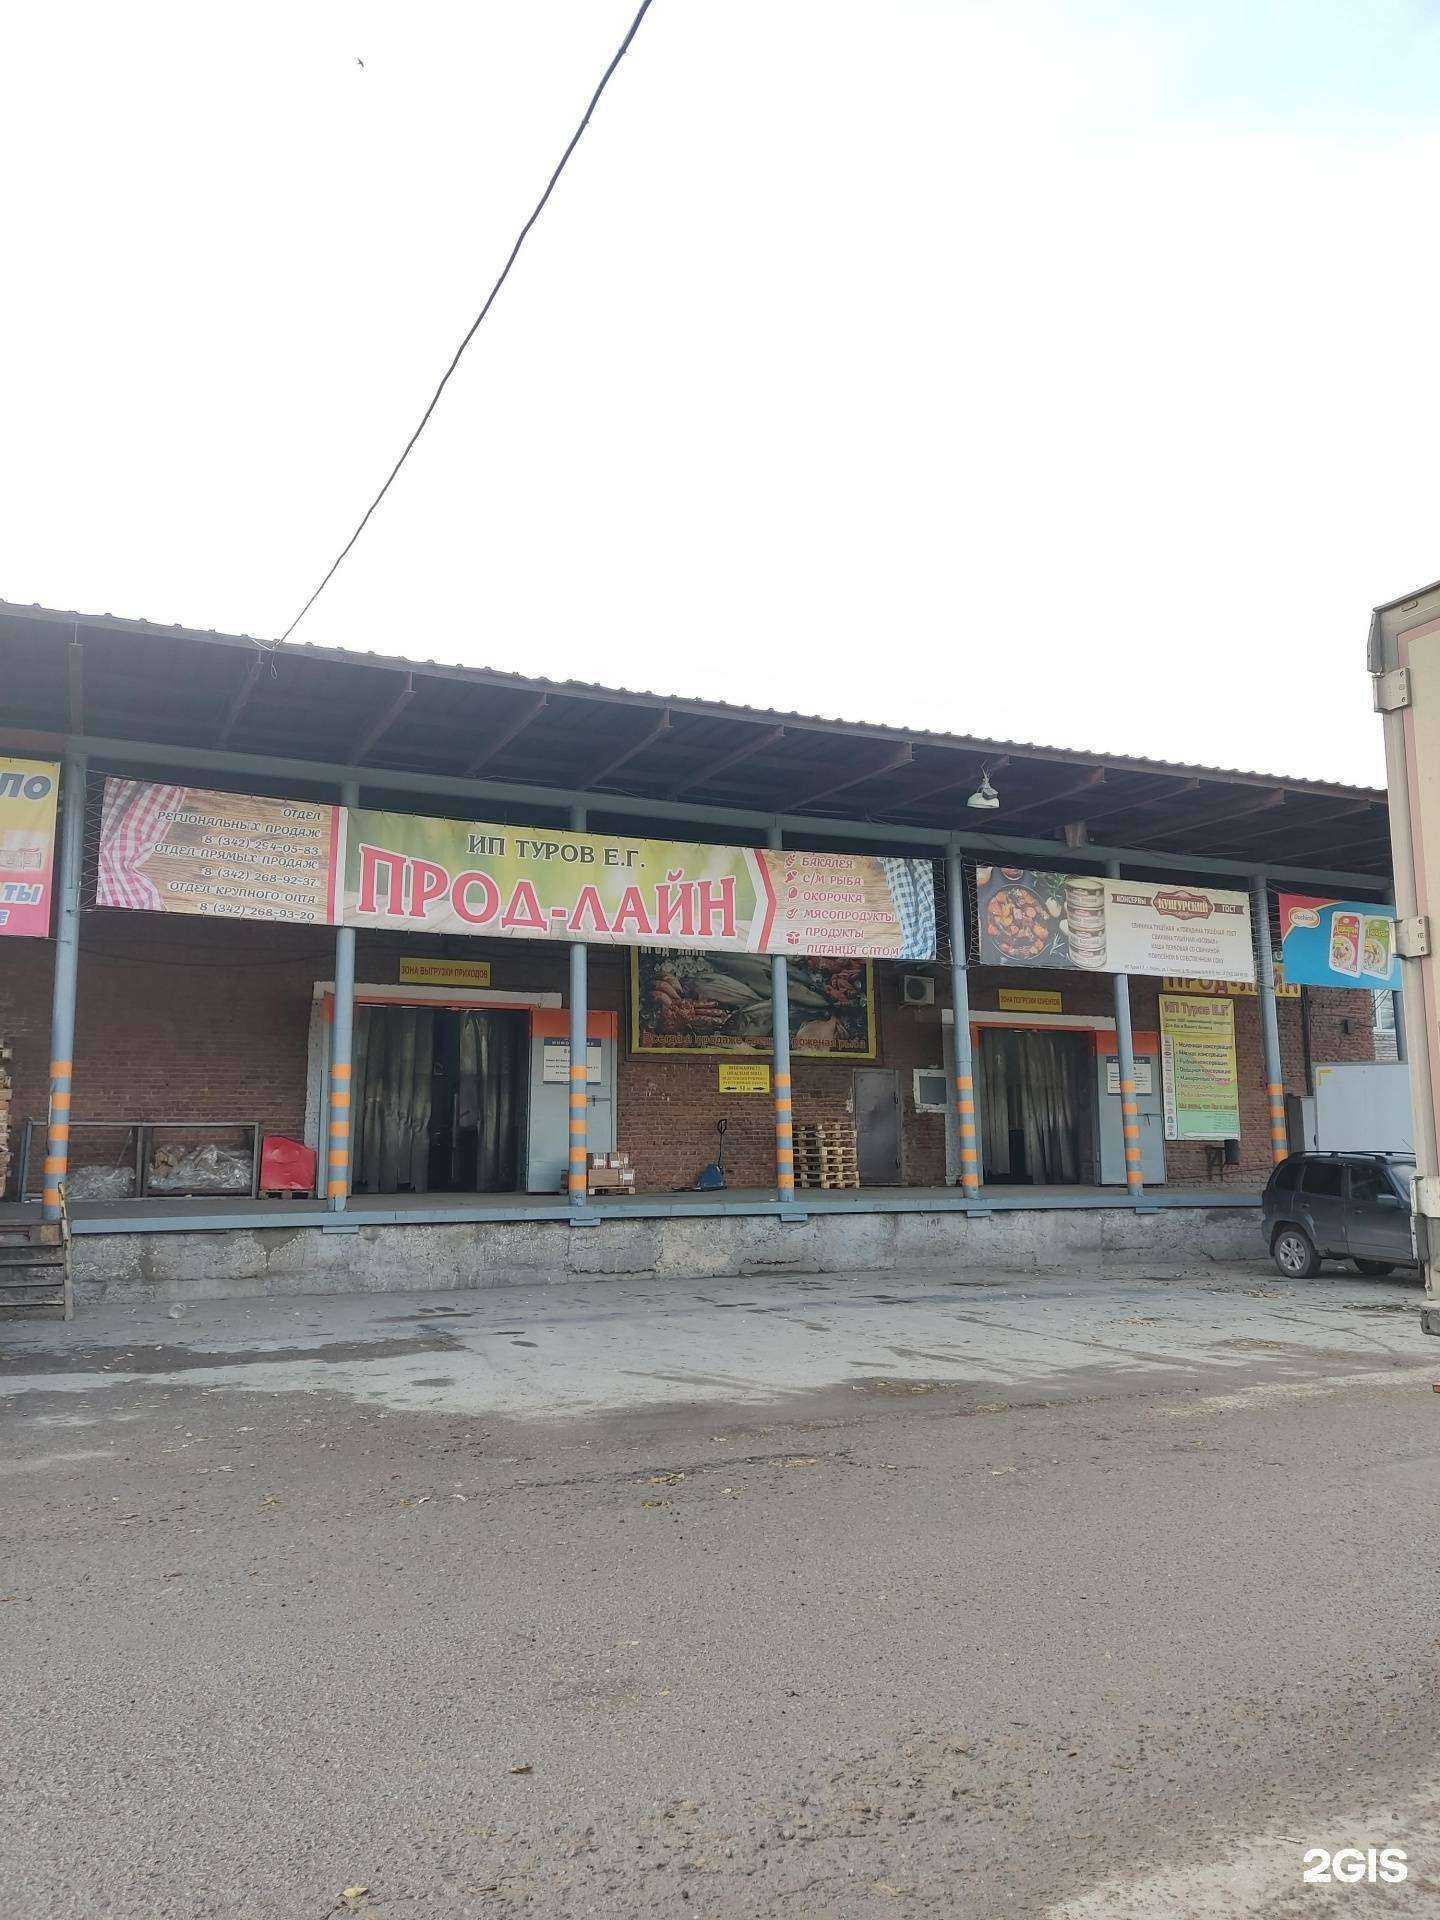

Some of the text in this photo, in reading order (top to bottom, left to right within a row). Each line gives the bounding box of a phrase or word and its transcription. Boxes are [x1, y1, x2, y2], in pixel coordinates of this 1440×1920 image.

[283, 808, 321, 821] ОТДЕЛ
[157, 811, 321, 838] РЕГИОНАЛЬНЫХ ПРОДАЖ
[203, 835, 213, 845] 8
[217, 835, 250, 849] (342)
[154, 843, 318, 870] ОТДЕЛ ПРЯМЫХ ПРОДАЖ
[467, 833, 646, 869] ИП ТУРОВ Е.Г.
[801, 856, 854, 869] БАКАЛЕЯ
[203, 867, 212, 876] 8
[217, 867, 250, 881] (342)
[802, 872, 862, 887] С/М РЫБА
[169, 881, 316, 904] ОТДЕЛ КРУПНОГО ОПТА
[357, 843, 738, 938] ПРОД-ЛАЙН
[803, 891, 863, 904] ОКОРОЧКА
[200, 902, 208, 912] 8
[213, 902, 246, 917] (342)
[804, 909, 895, 923] МЯСОПРОДУКТЫ
[805, 927, 864, 939] ПРОДУКТЫ
[806, 944, 900, 957] ПИТАНИЯ ОПТОМ
